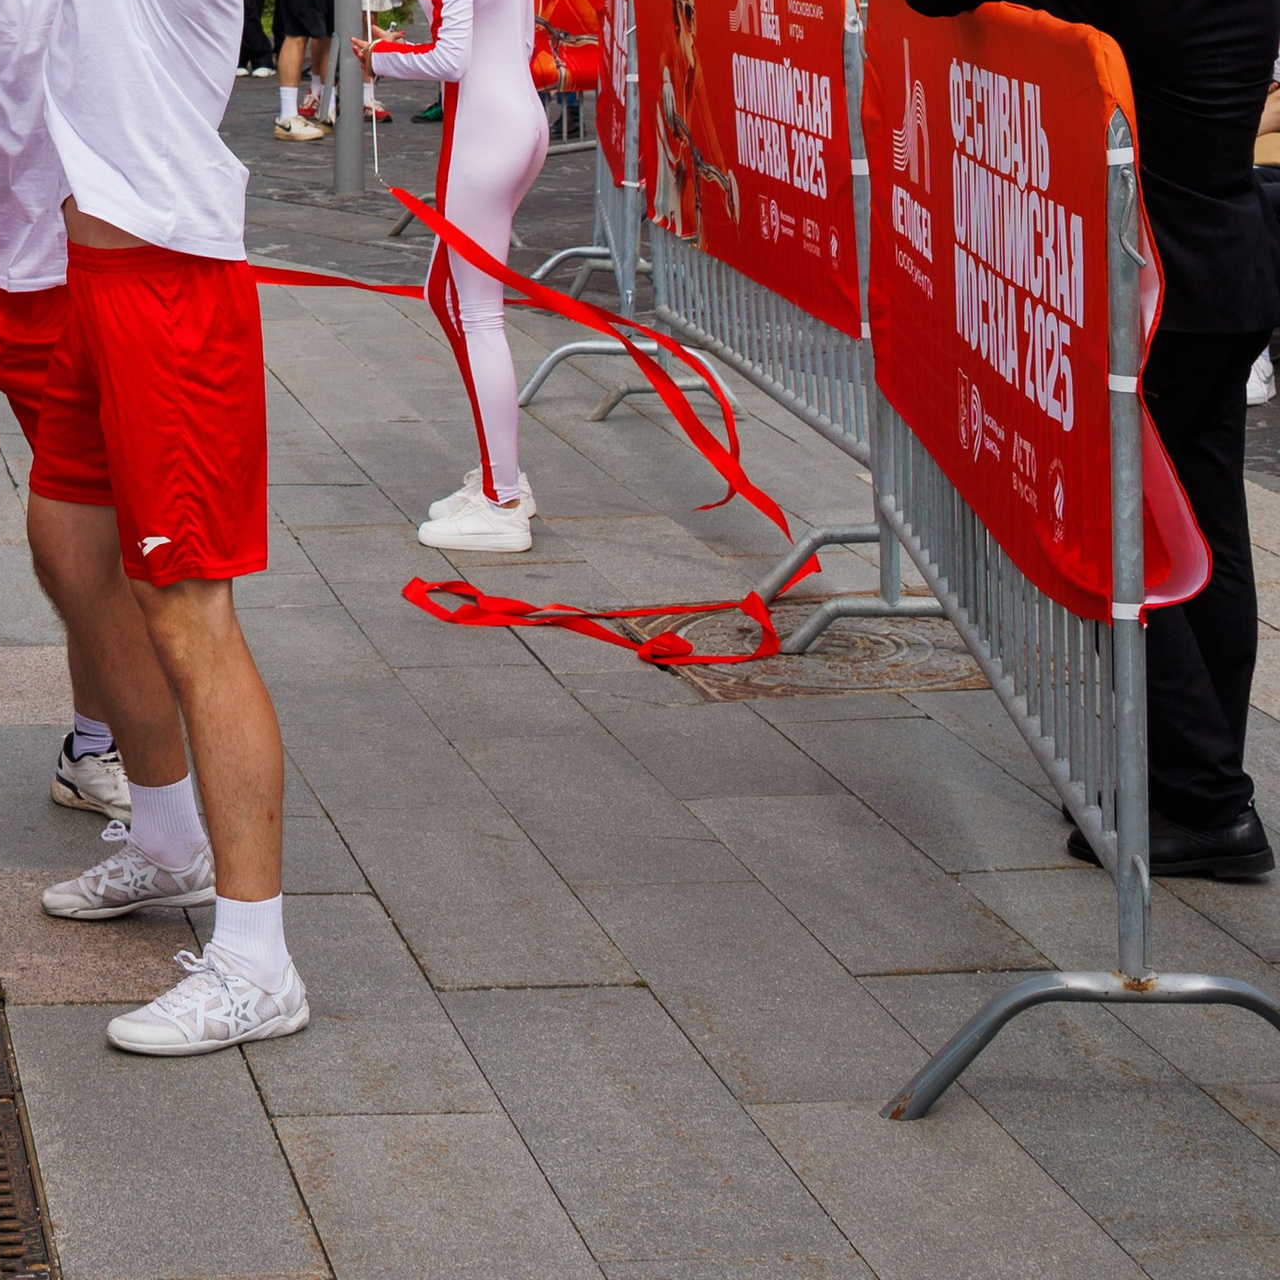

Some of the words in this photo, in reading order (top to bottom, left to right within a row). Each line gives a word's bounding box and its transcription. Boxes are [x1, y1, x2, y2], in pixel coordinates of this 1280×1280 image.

[789, 23, 804, 42] игры
[732, 52, 832, 139] ОЛИМПИЙСКАЯ
[949, 58, 1050, 191] ФЕСТИВАЛЬ
[735, 109, 790, 184] МОСКВА
[791, 128, 827, 200] 2025
[953, 148, 1083, 328] ОЛИМПИЙСКАЯ
[954, 243, 1019, 389] МОСКВА
[1024, 296, 1074, 432] 2025
